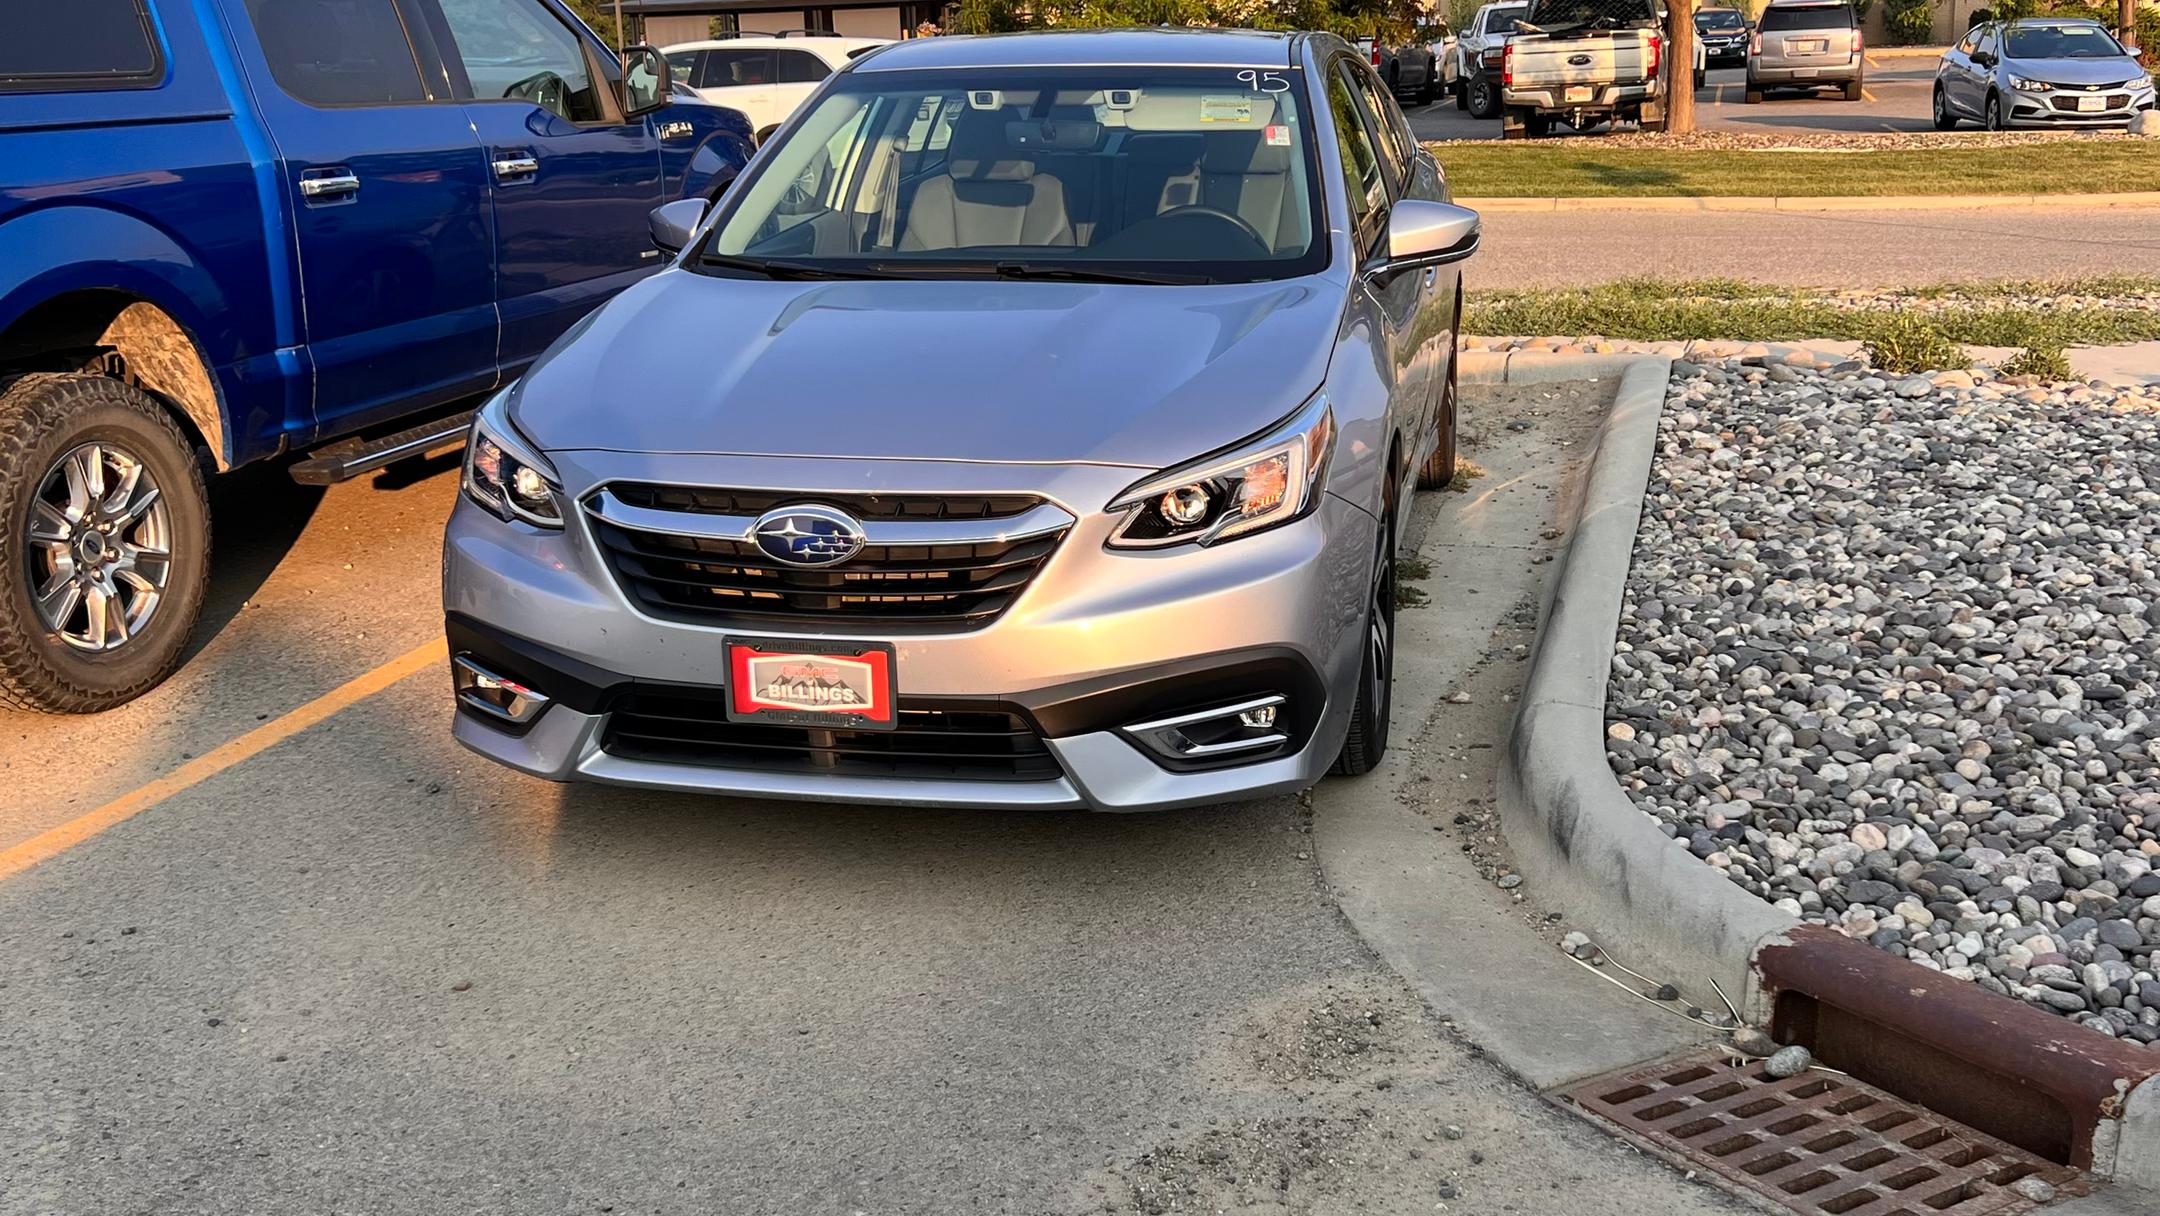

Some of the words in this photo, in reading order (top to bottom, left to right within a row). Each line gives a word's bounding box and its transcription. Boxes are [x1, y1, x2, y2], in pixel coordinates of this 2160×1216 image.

[1237, 69, 1290, 92] 95
[780, 664, 839, 679] GMC
[768, 684, 855, 702] BILLINGS
